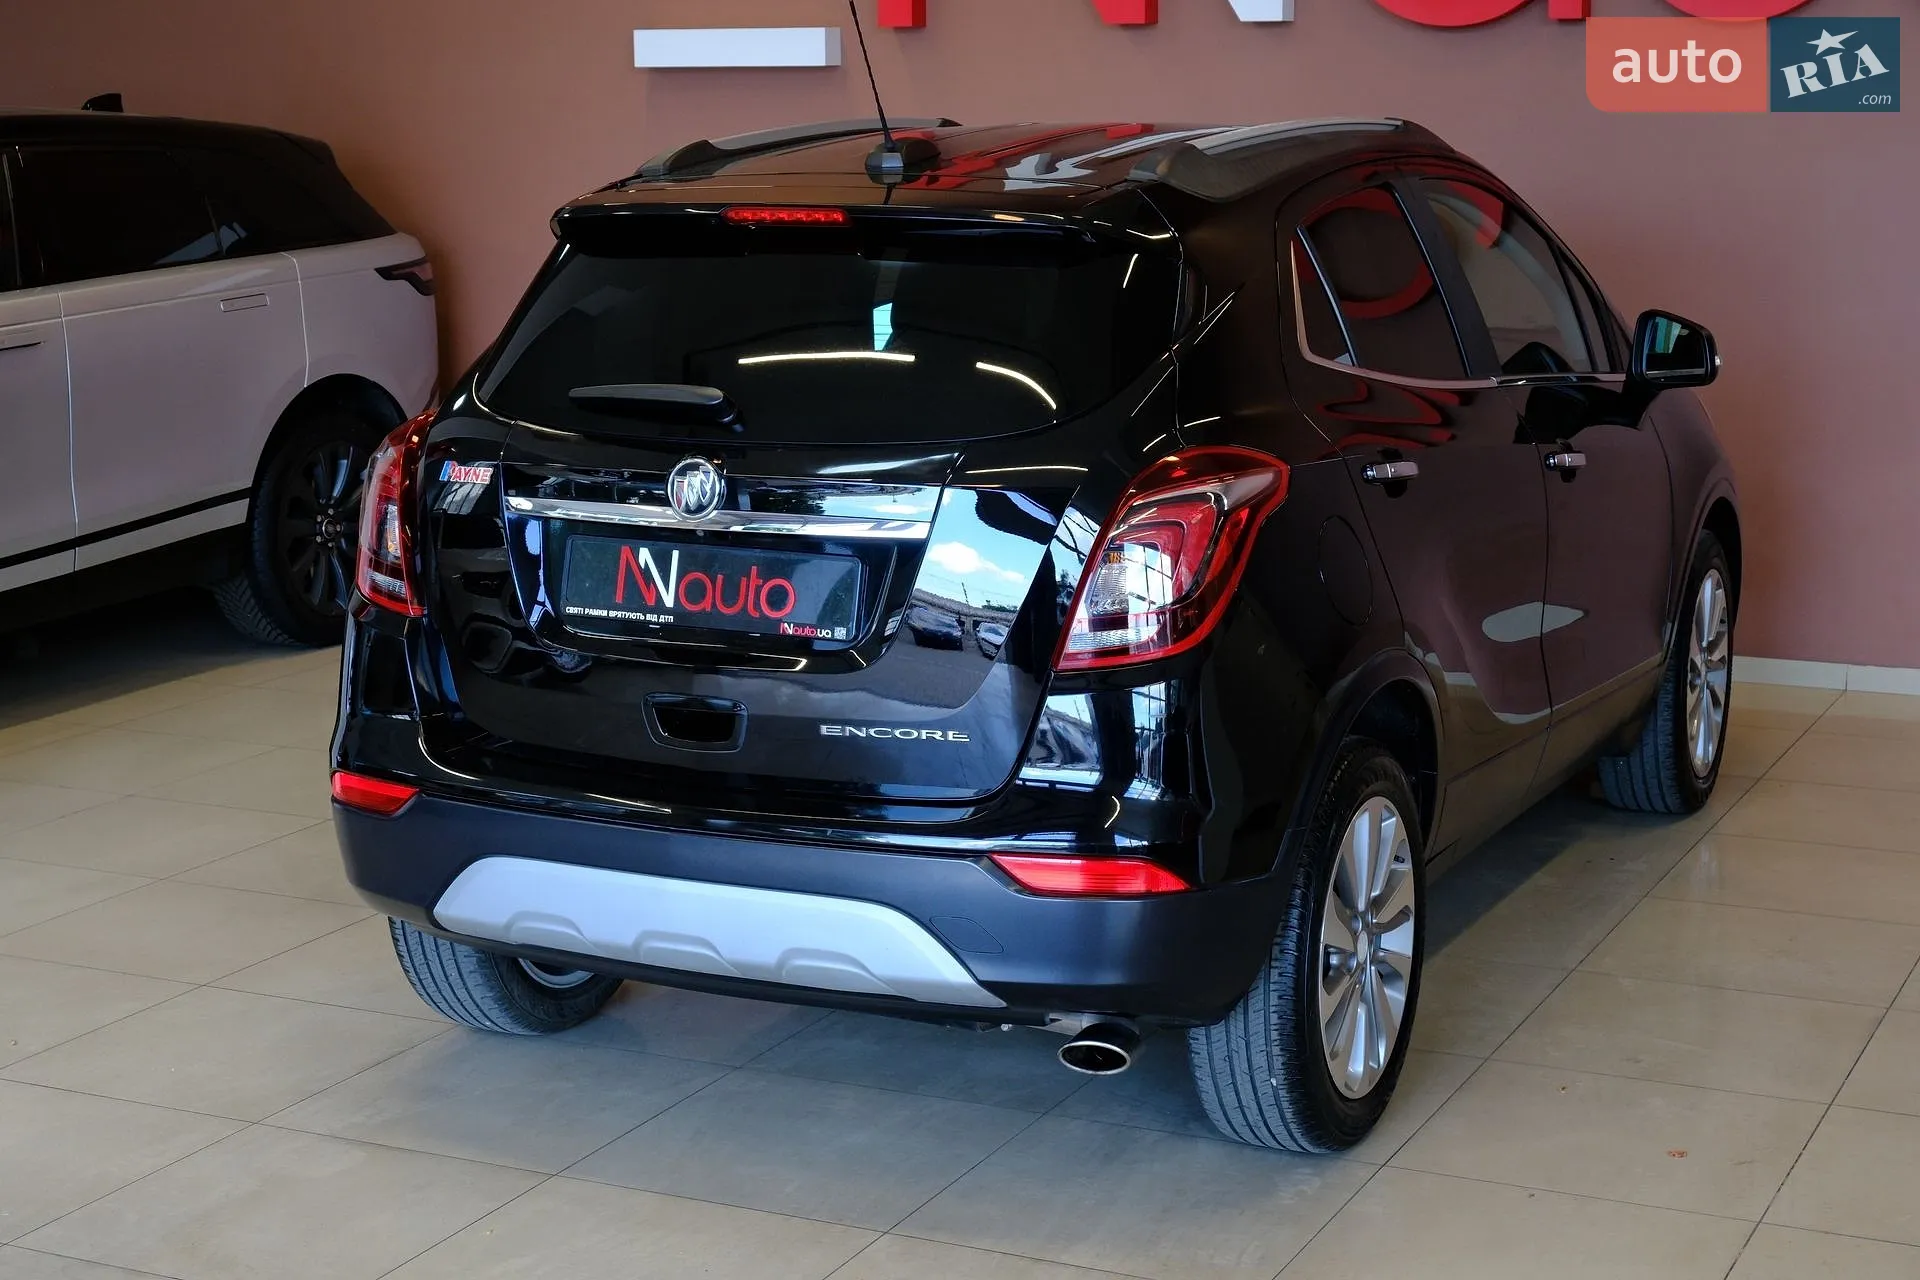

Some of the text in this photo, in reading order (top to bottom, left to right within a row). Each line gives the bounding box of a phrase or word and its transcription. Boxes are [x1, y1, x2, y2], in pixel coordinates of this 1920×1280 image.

[584, 608, 608, 616] РАМКИ
[645, 613, 658, 622] ВІД
[659, 615, 674, 623] ДТП
[820, 725, 970, 742] ENCORE
